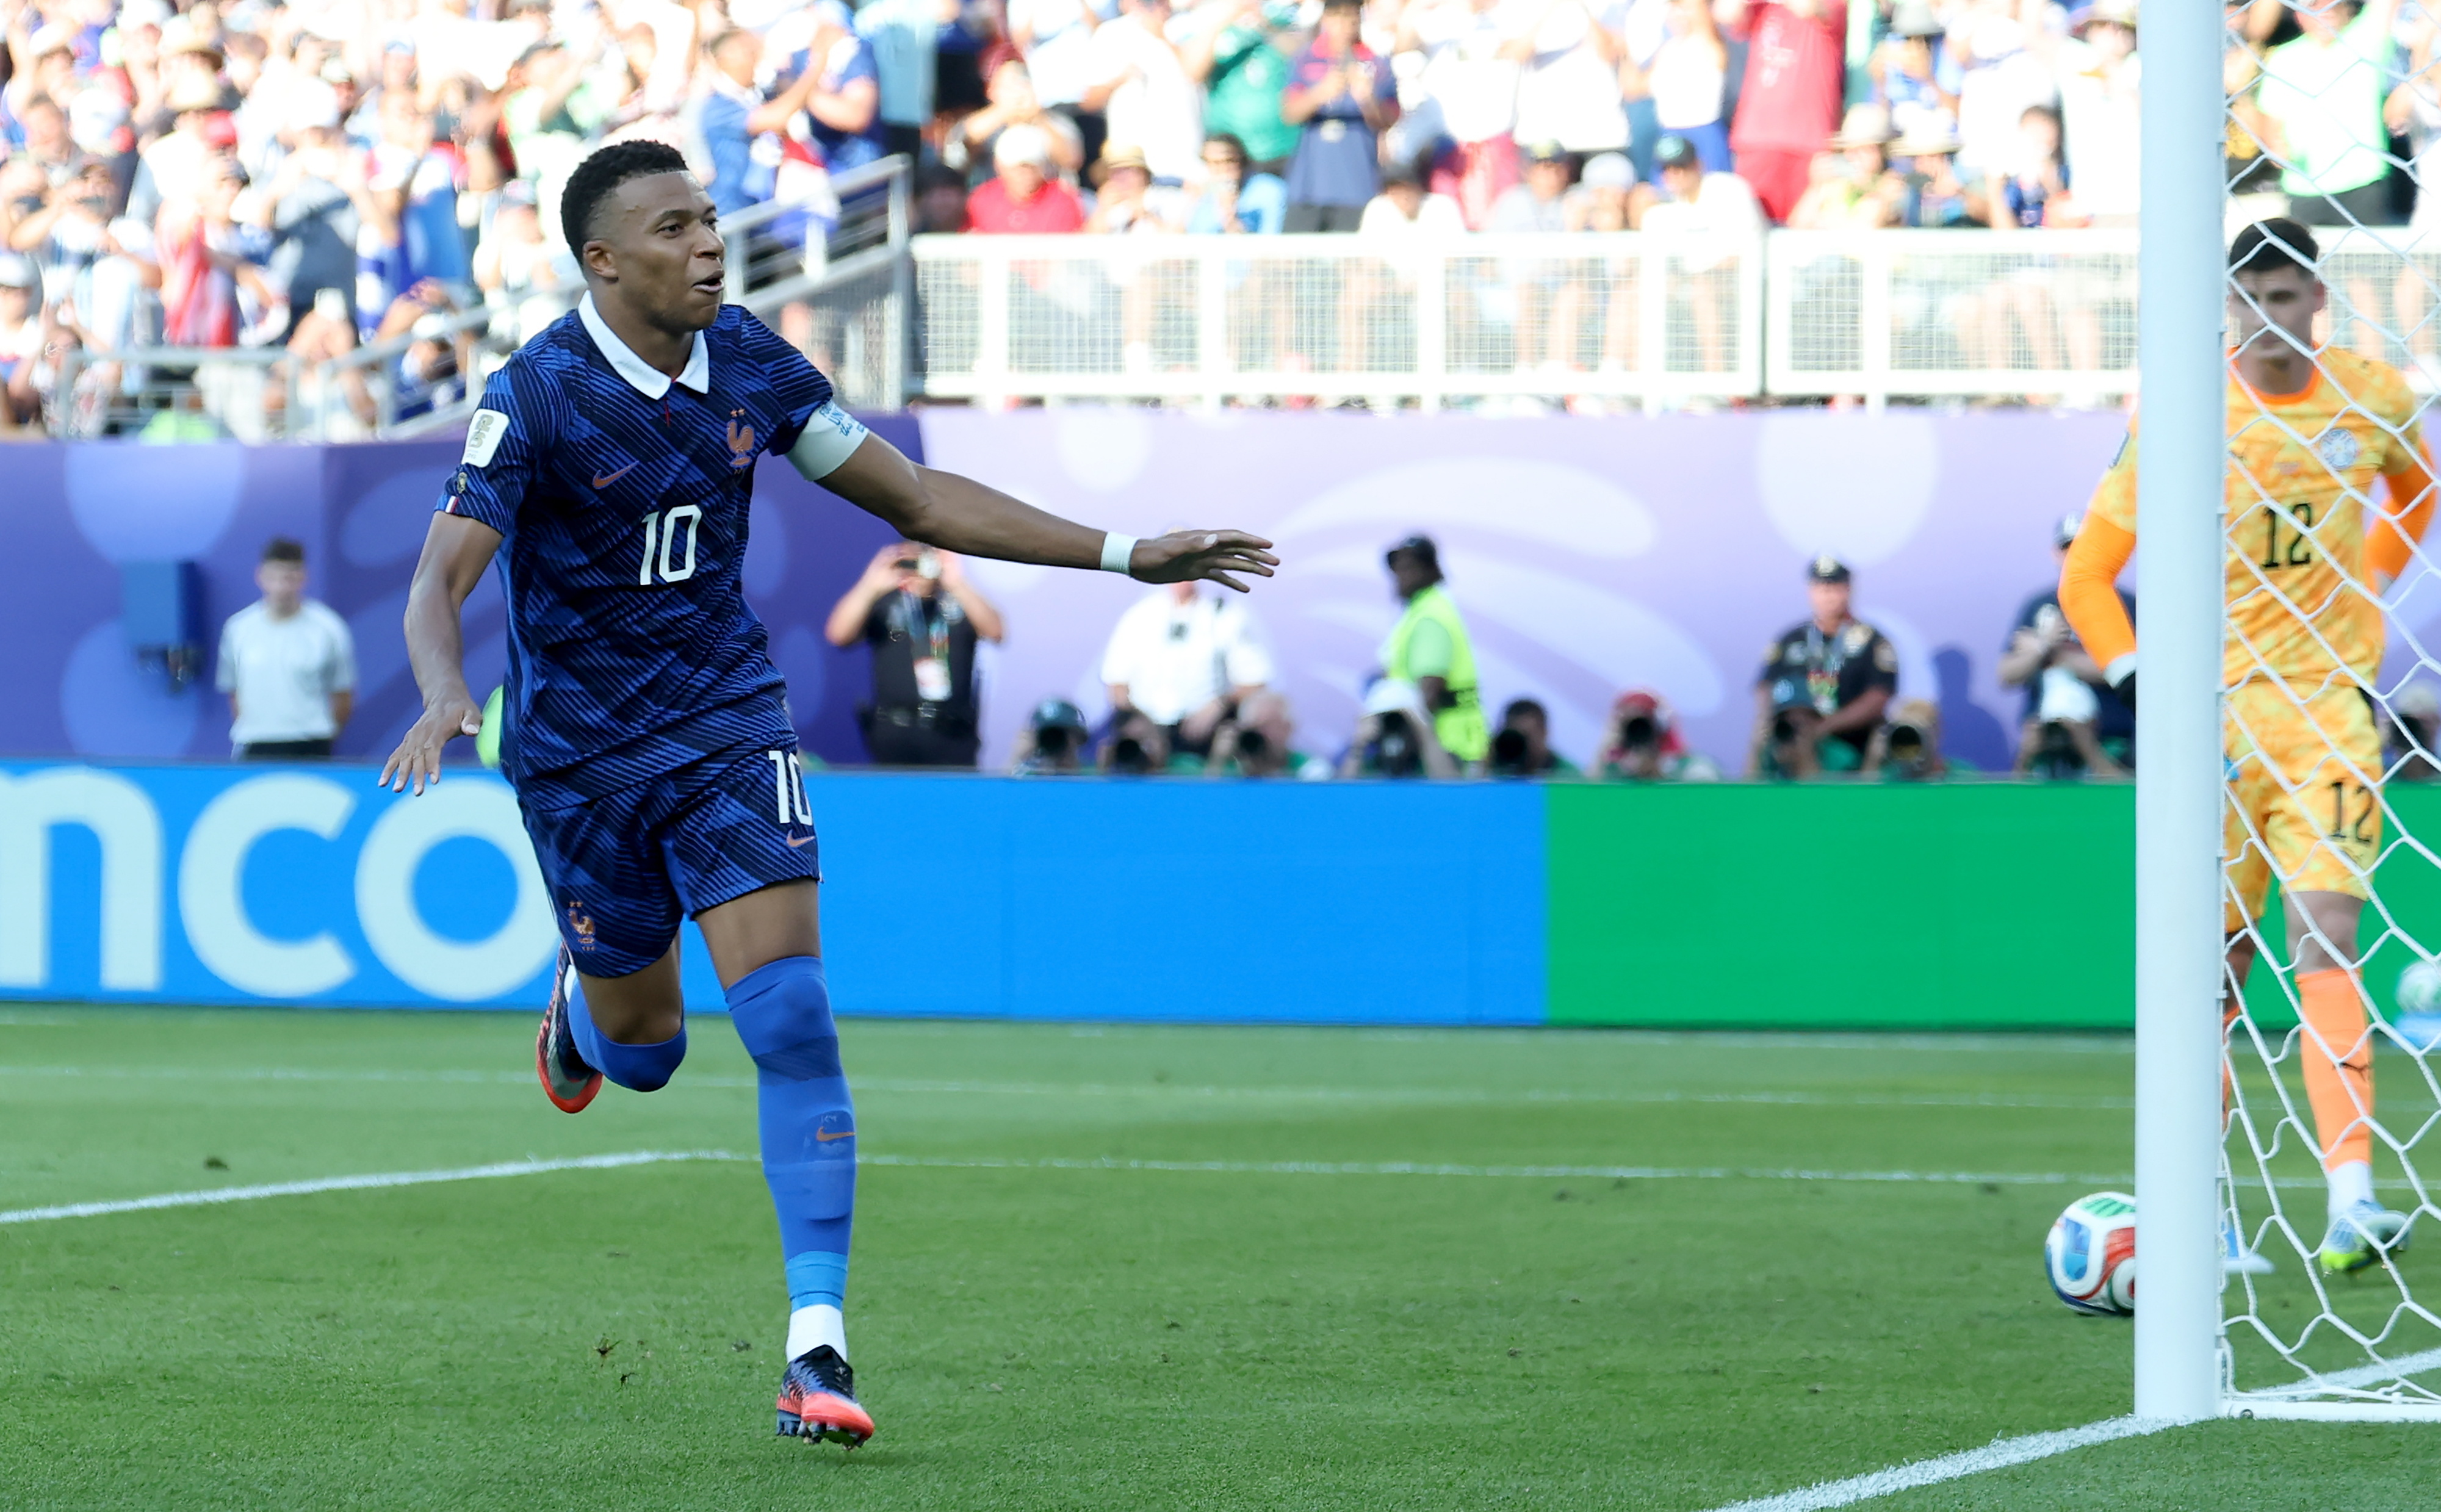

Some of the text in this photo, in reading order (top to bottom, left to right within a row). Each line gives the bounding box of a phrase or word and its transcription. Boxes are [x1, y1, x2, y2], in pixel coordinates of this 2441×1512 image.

[640, 504, 702, 586] 10
[2262, 503, 2311, 567] 12
[768, 750, 813, 826] 10
[2327, 780, 2373, 844] 12
